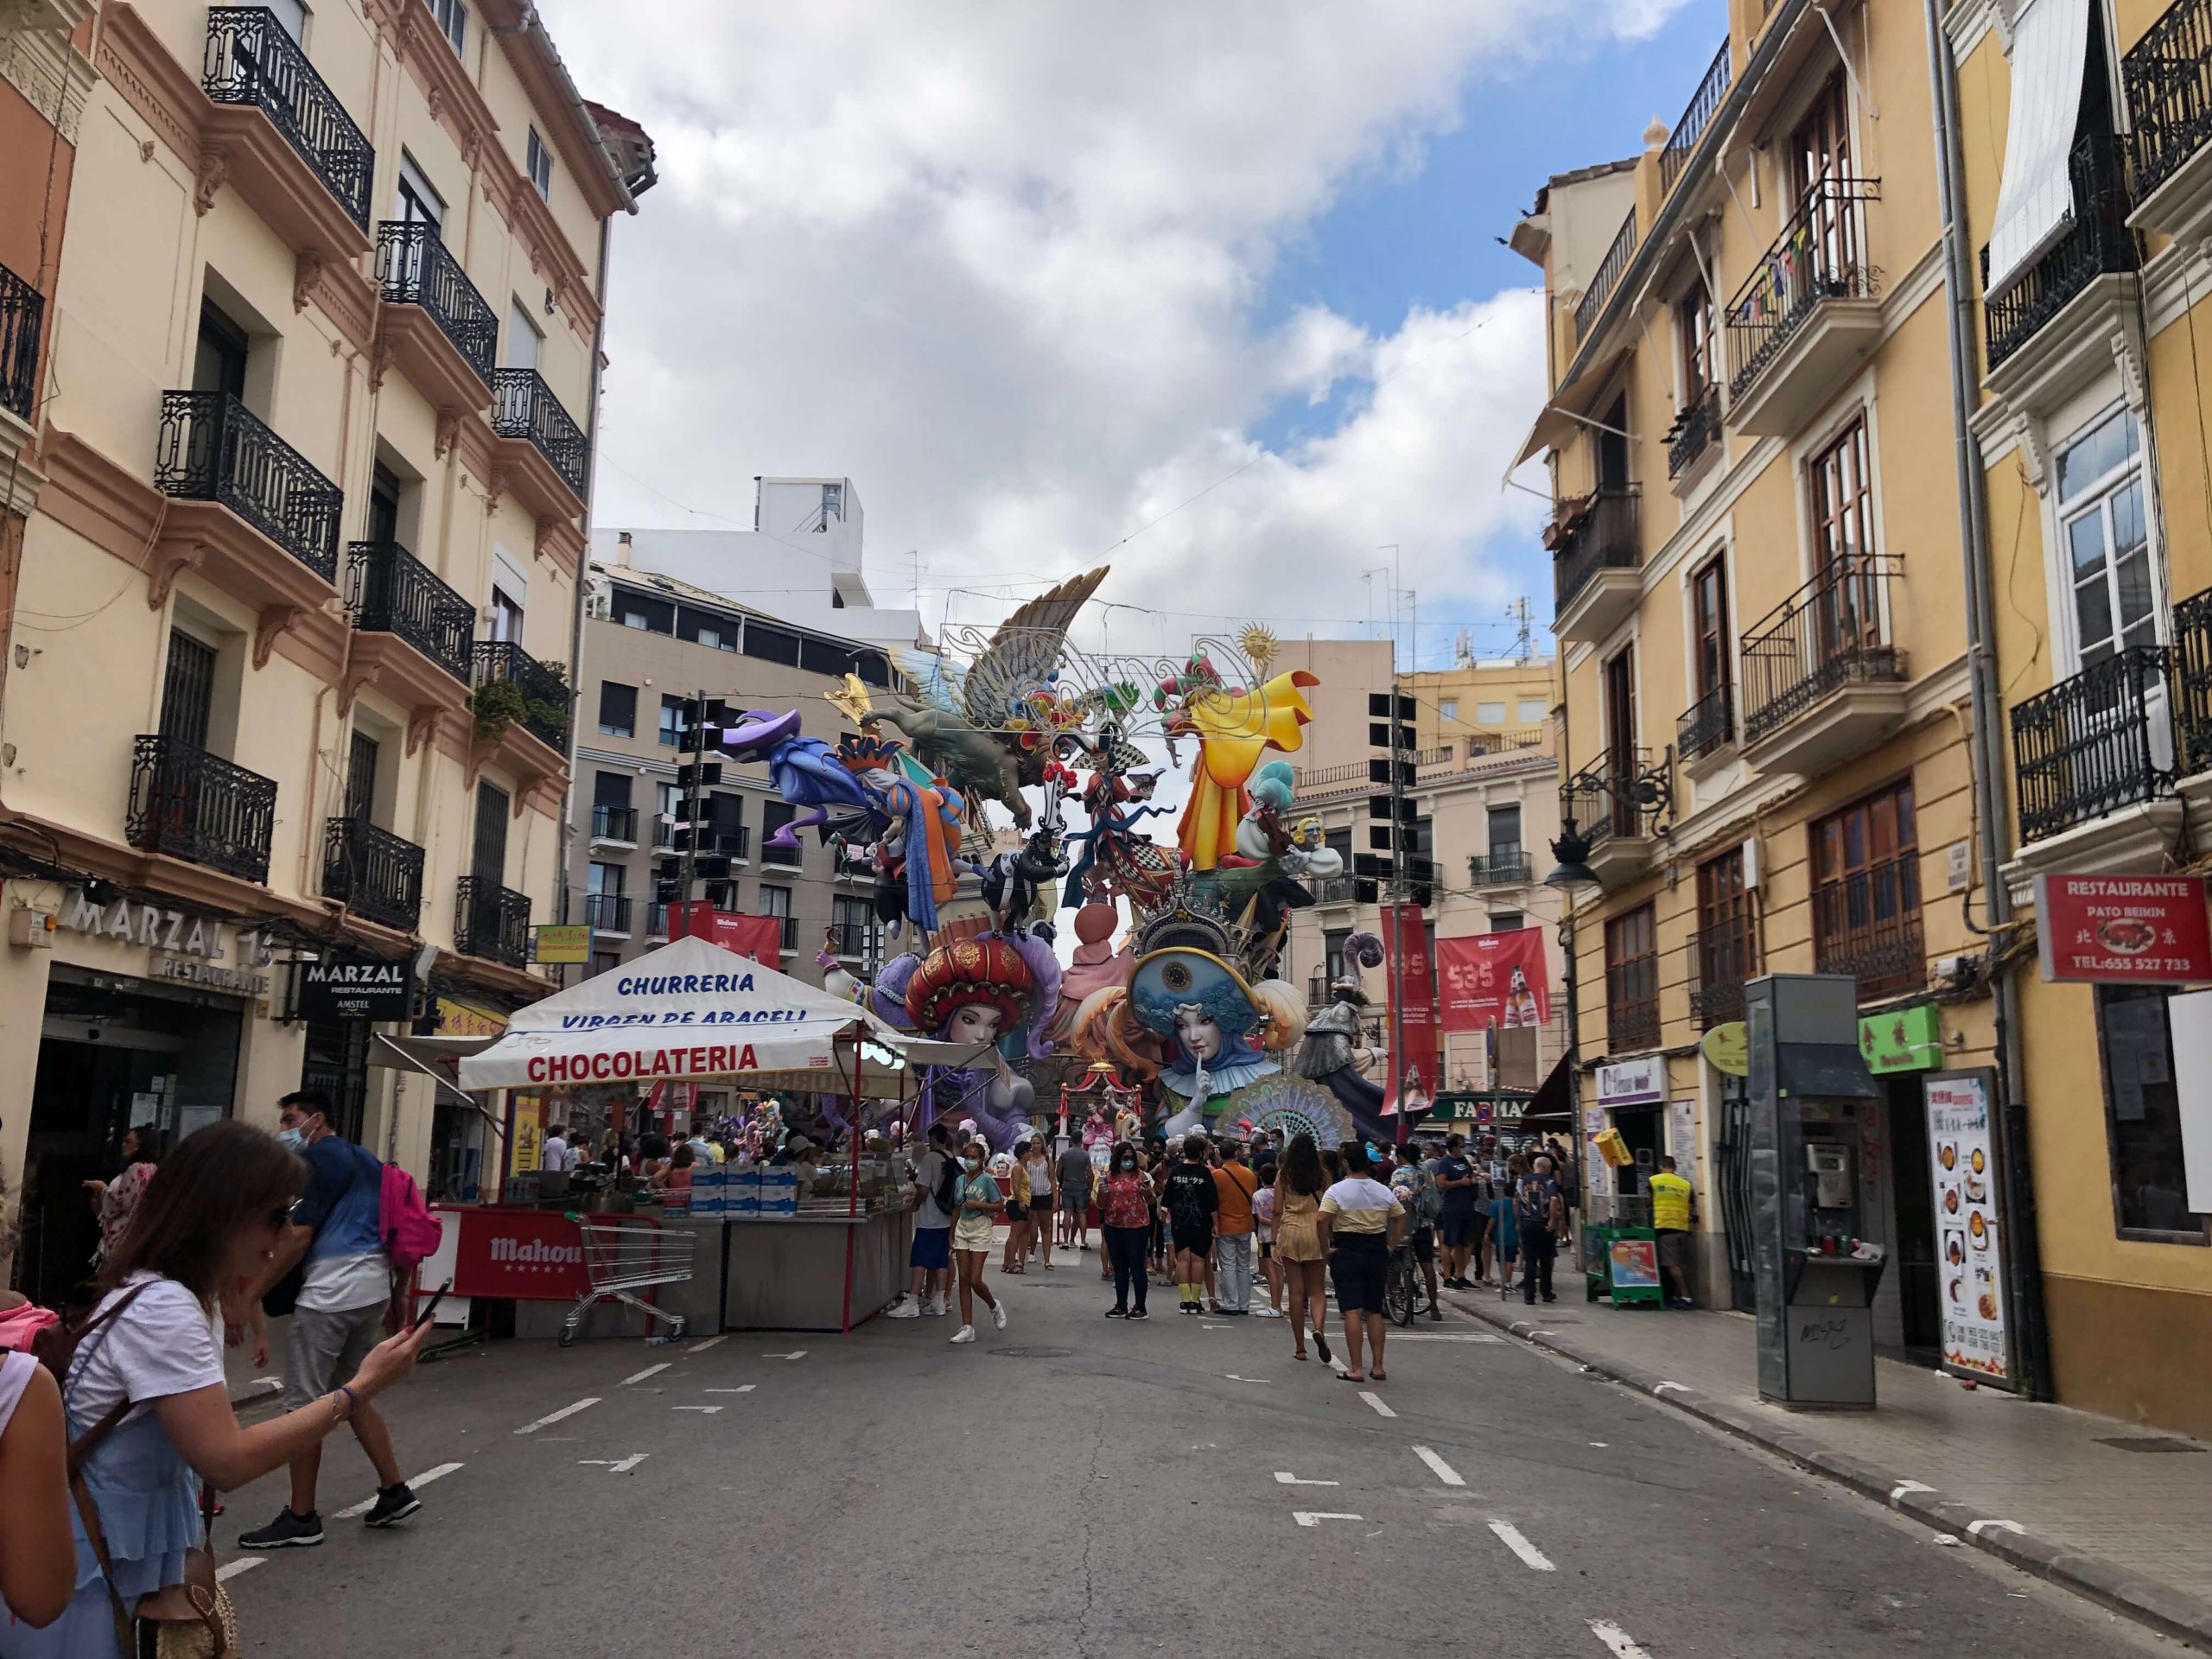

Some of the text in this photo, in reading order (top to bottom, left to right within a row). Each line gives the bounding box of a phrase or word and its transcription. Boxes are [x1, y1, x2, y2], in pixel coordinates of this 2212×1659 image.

[2067, 880, 2189, 897] RESTAURANTE
[2087, 906, 2165, 918] PATO BEIKIN
[68, 891, 225, 959] MARZAL
[307, 964, 404, 982] MARZAL
[2135, 958, 2160, 970] 527
[2164, 958, 2190, 970] 733
[161, 958, 270, 994] RESTAURANTE
[618, 973, 754, 995] CHURRERIA
[336, 1000, 370, 1008] AMSTEL
[662, 1011, 695, 1026] DE
[701, 1008, 806, 1025] ARACELI
[527, 1044, 758, 1082] CHOCOLATERIA
[490, 1237, 582, 1263] Mahou
